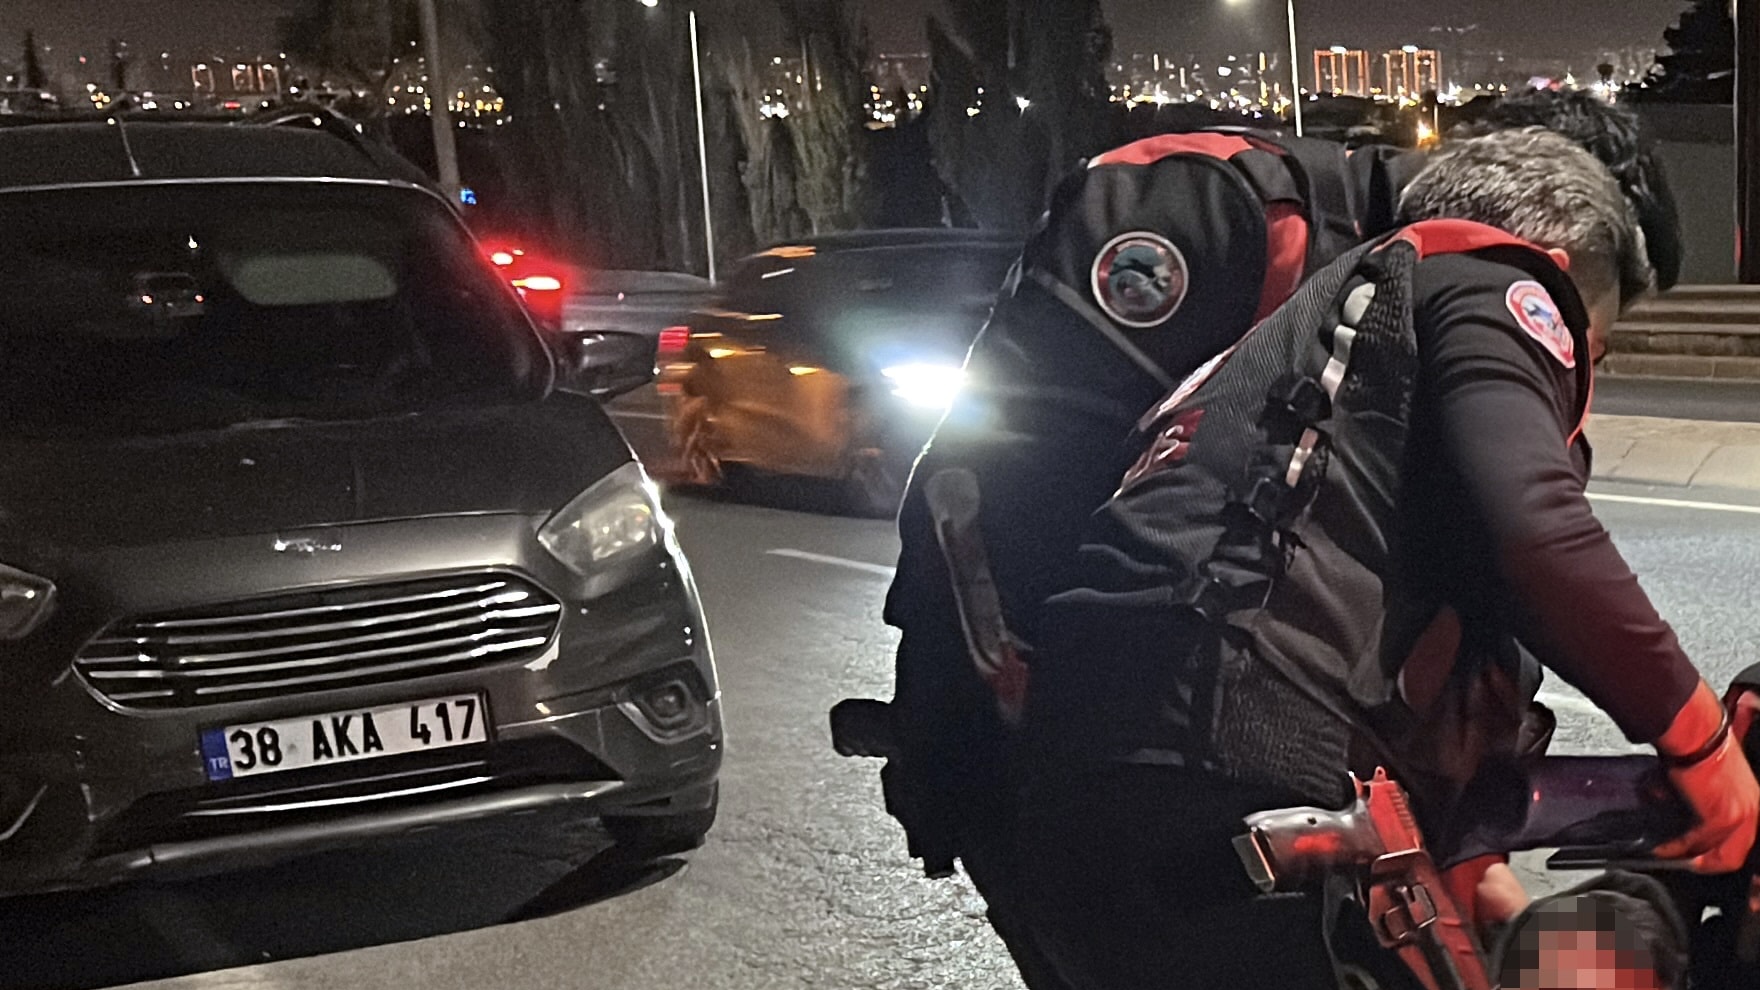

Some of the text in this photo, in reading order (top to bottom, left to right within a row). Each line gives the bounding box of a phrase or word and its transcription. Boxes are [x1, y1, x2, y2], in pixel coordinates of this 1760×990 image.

[229, 698, 478, 770] 38 AKA 417
[210, 757, 229, 770] TR
